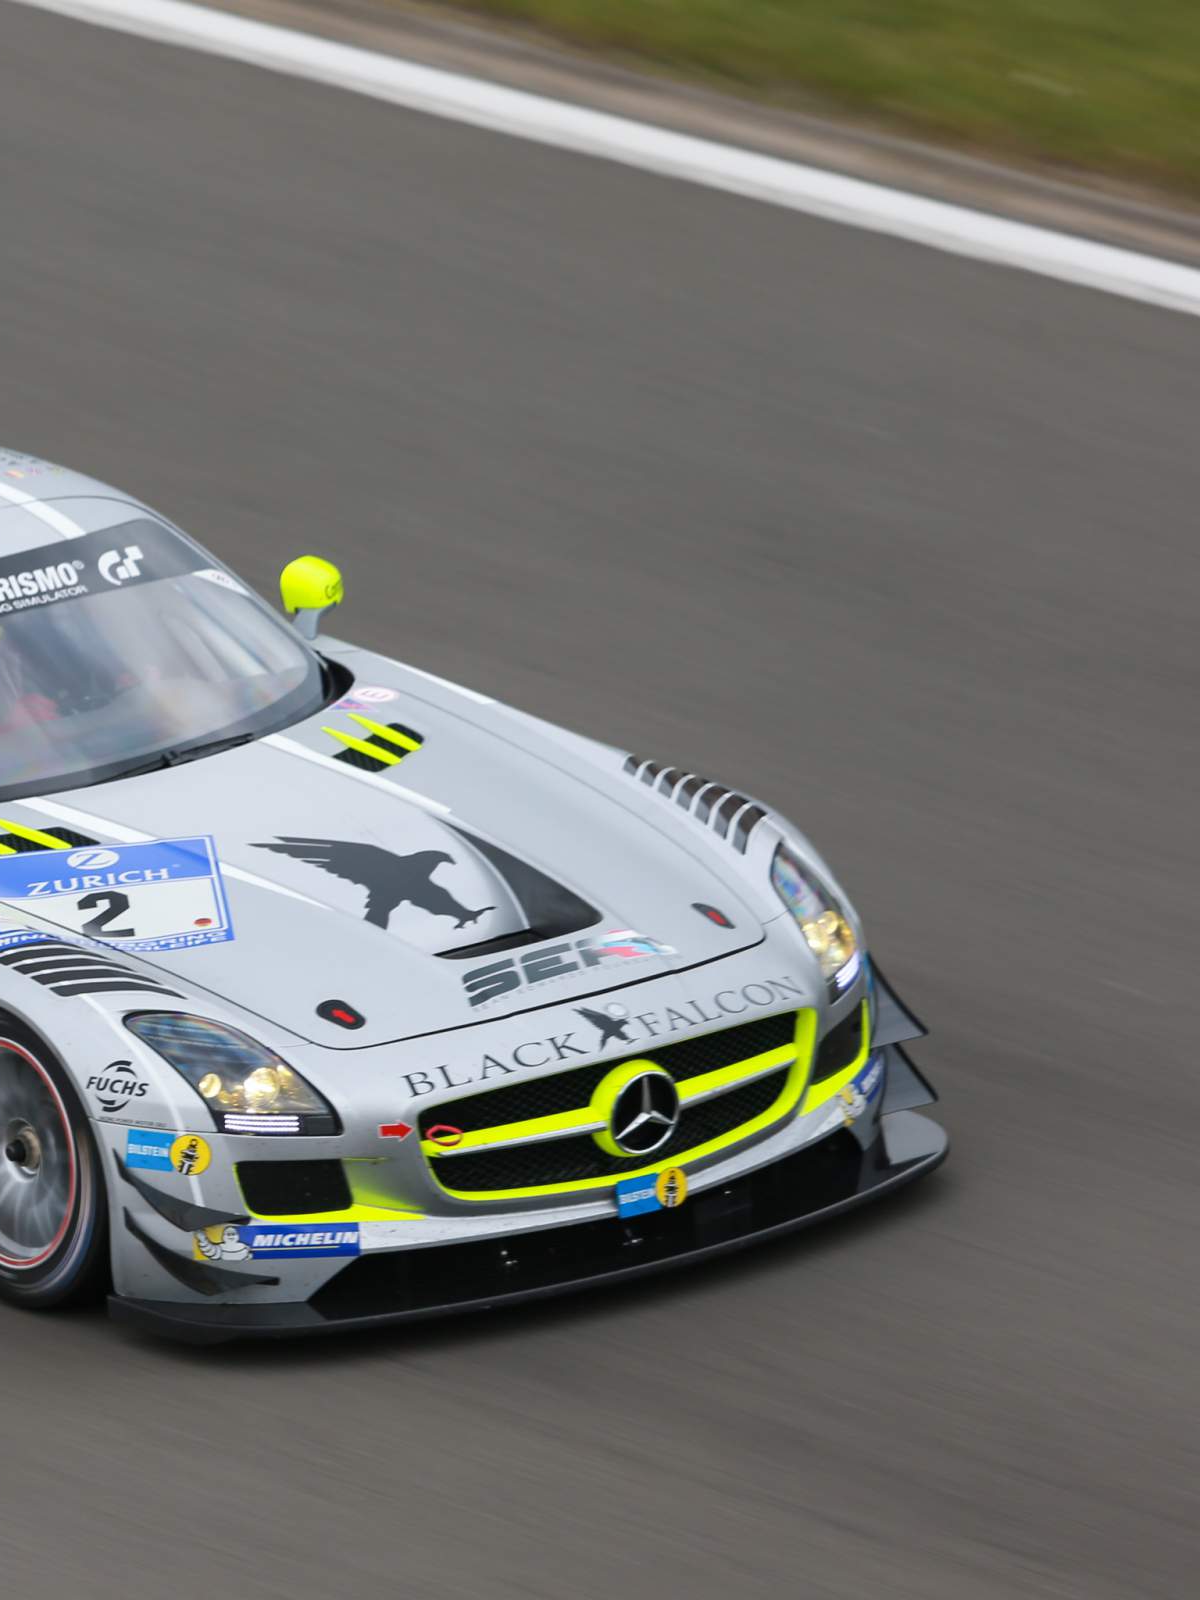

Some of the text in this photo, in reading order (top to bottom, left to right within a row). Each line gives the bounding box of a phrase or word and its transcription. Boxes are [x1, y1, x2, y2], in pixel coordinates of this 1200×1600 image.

[12, 584, 89, 611] SIMULATOR
[26, 867, 170, 897] ZURICH
[77, 890, 135, 938] 2
[401, 1033, 590, 1098] BLACK
[634, 976, 806, 1037] FALCON
[85, 1075, 149, 1098] FUCHS
[252, 1231, 359, 1248] MICHELIN
